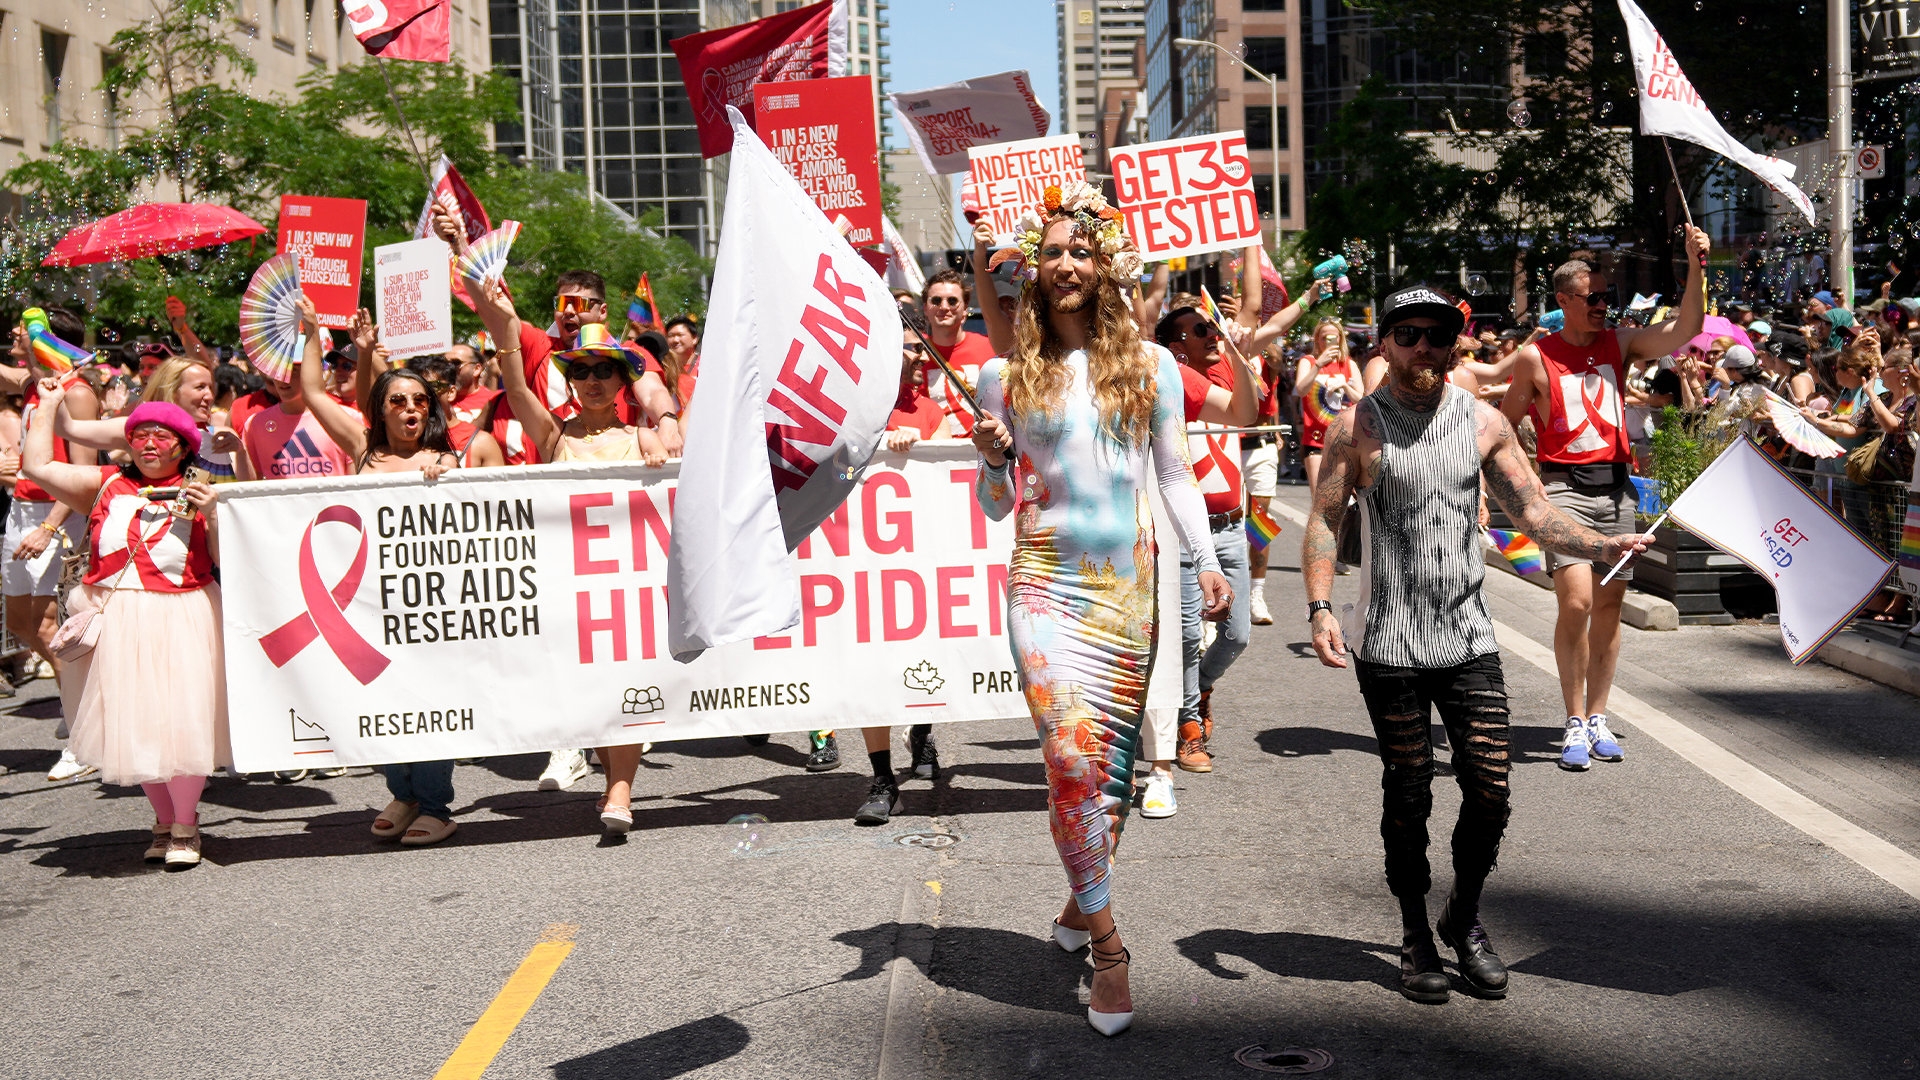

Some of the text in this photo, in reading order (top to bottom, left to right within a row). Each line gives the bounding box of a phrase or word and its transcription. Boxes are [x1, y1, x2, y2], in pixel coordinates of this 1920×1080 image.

[725, 82, 743, 99] FOR
[913, 107, 974, 129] SUPPORT
[770, 124, 839, 147] 1 IN 5 NEW
[796, 142, 837, 162] CASES
[932, 140, 954, 156] SEX
[801, 158, 847, 179] AMONG
[970, 144, 1085, 184] INDÉTECTAB
[1111, 137, 1252, 204] GET 35
[825, 173, 857, 193] WHO
[820, 190, 867, 211] DRUGS.
[1120, 188, 1261, 253] TESTED
[286, 230, 354, 248] 1 IN 3 NEW HIV
[303, 258, 348, 273] THROUGH
[383, 269, 429, 287] 1 SUR 10 DES
[383, 282, 420, 297] NOUVEAUX
[383, 291, 422, 307] CAS DE VIH
[384, 302, 417, 317] SONT DES
[384, 311, 427, 327] PERSONNES
[384, 320, 437, 338] AUTOCHTONES.
[270, 459, 333, 476] adidas
[377, 498, 535, 539] CANADIAN
[1773, 518, 1809, 547] GET
[378, 535, 536, 570] FOUNDATION
[380, 565, 538, 610] FOR AIDS
[383, 604, 540, 645] RESEARCH
[689, 682, 810, 714] AWARENESS
[358, 708, 474, 738] RESEARCH
